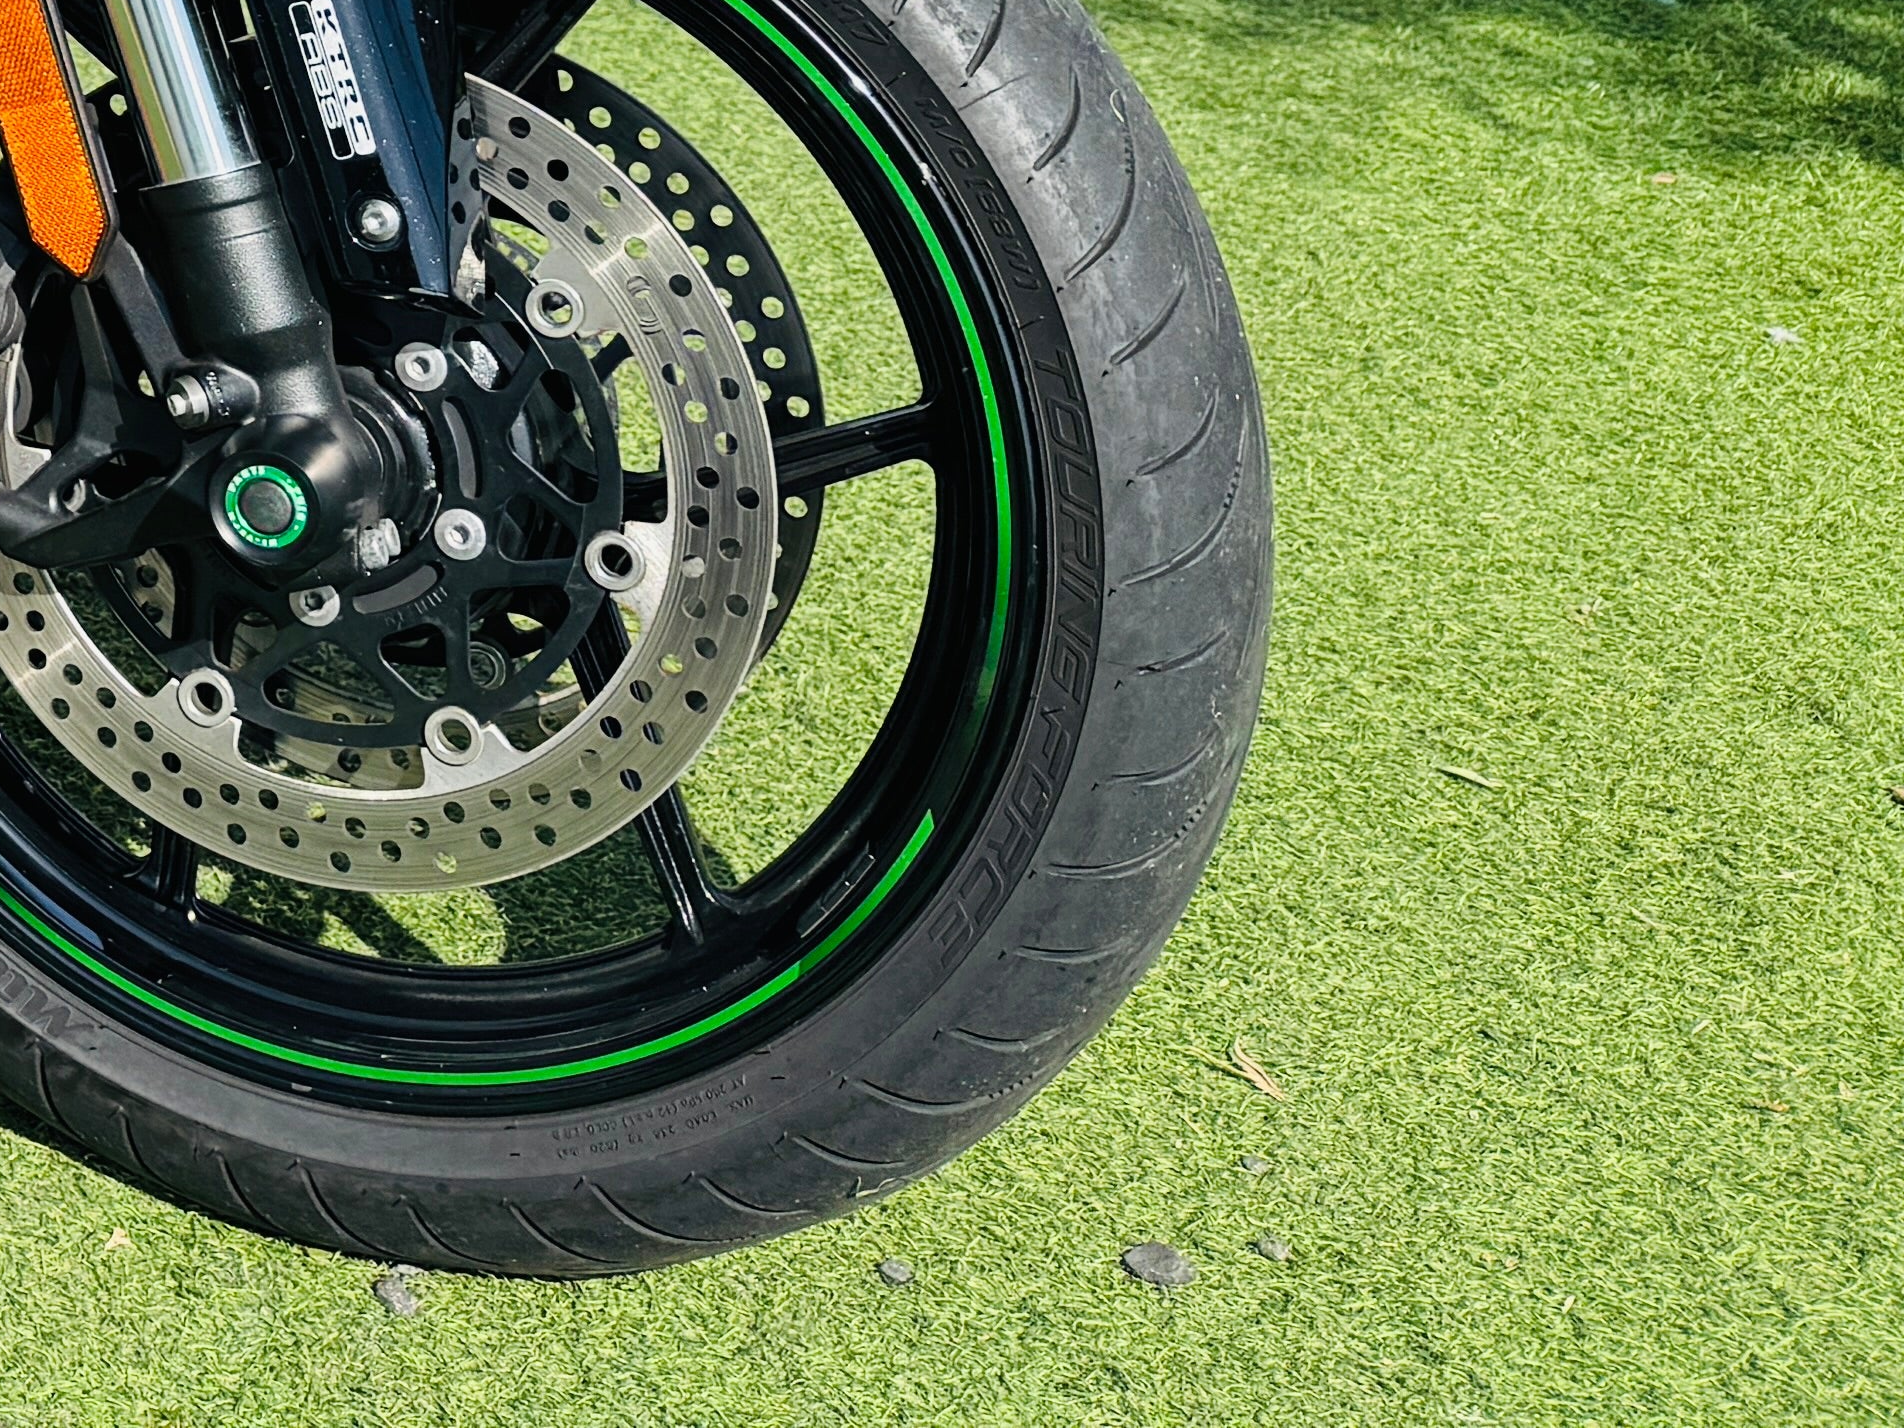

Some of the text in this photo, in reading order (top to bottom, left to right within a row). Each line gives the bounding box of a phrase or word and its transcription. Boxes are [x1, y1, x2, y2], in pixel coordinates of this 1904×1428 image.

[300, 31, 345, 131] ABS
[316, 8, 372, 145] KTRC
[928, 346, 1102, 970] TOURING FORCE
